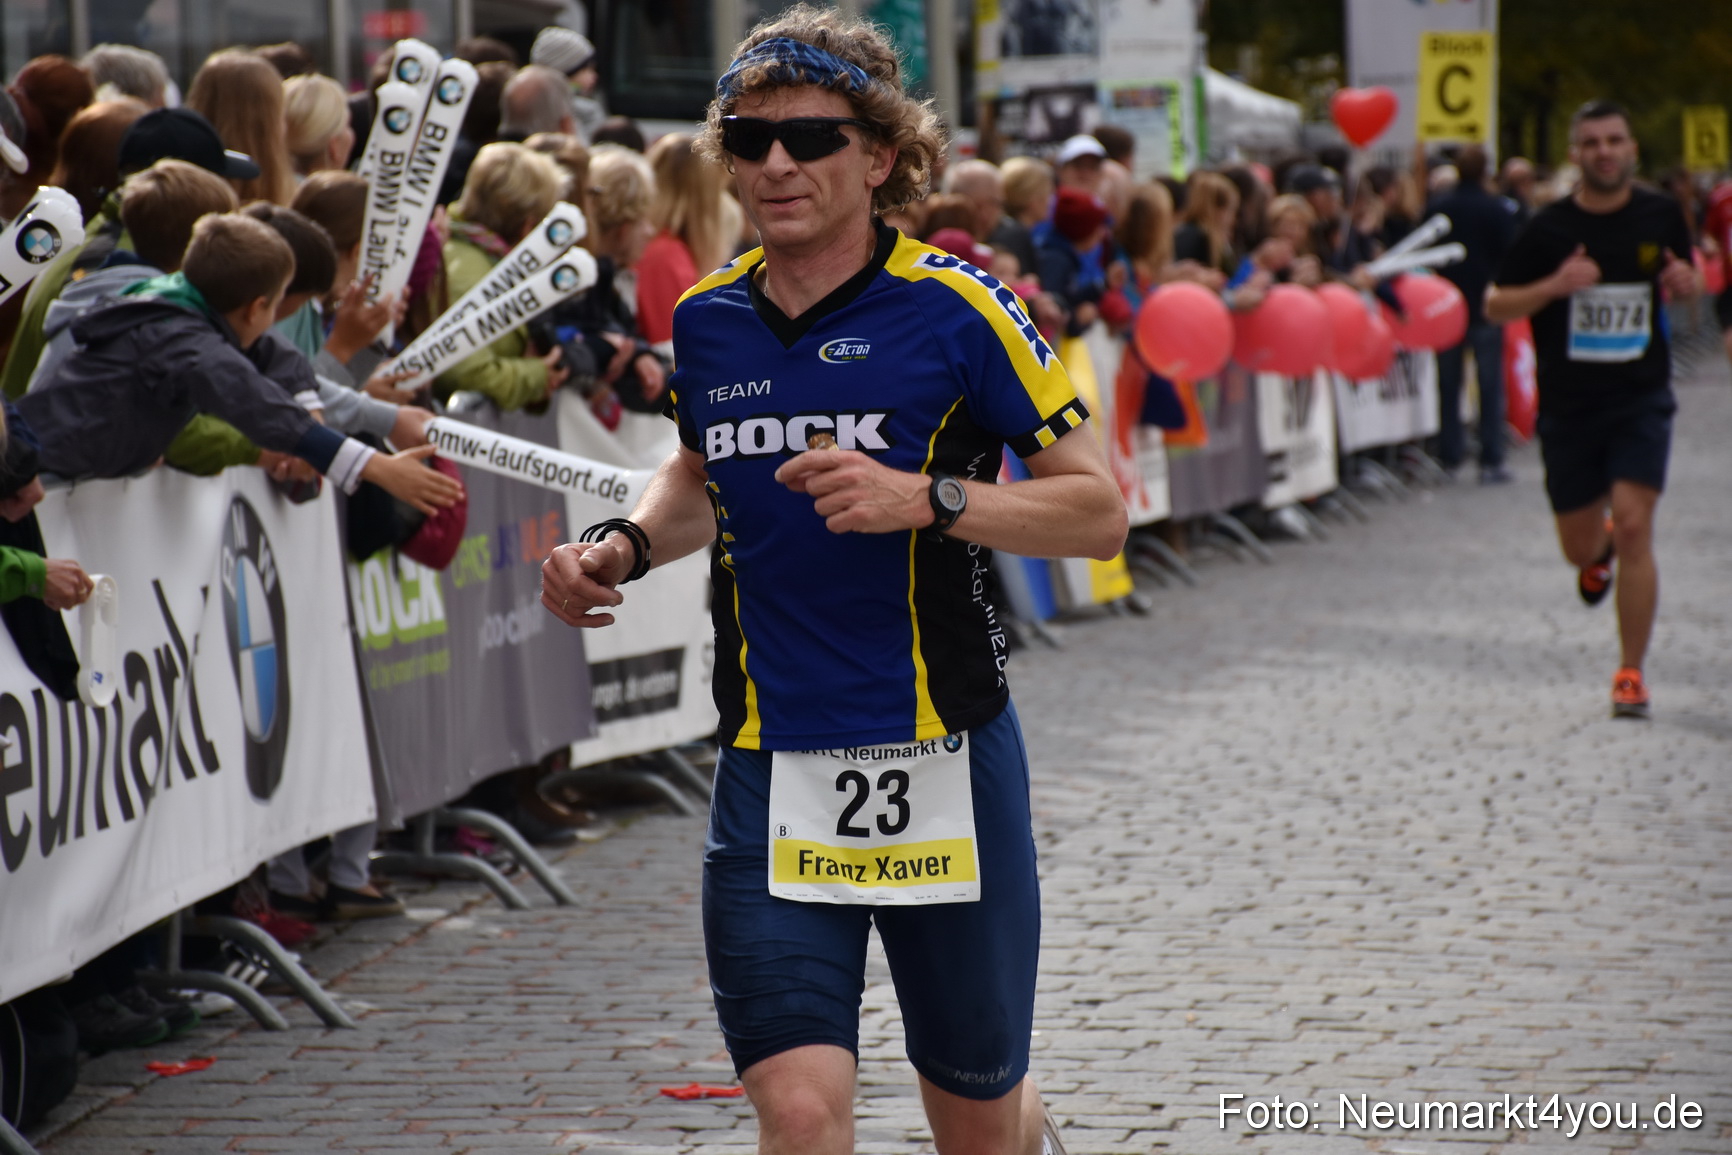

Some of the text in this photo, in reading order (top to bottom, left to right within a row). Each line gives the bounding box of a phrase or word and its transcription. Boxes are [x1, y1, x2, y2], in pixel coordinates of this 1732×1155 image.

[1435, 63, 1473, 117] C
[372, 151, 405, 214] BMW
[406, 121, 448, 197] BMW
[481, 248, 541, 303] BMW
[476, 287, 541, 342] BMW
[1578, 302, 1644, 331] 3074
[707, 379, 771, 404] TEAM
[705, 413, 891, 462] BOCK
[844, 740, 938, 760] Neumarkt
[836, 769, 911, 838] 23
[779, 825, 787, 837] B
[799, 849, 951, 883] Franz Xaver
